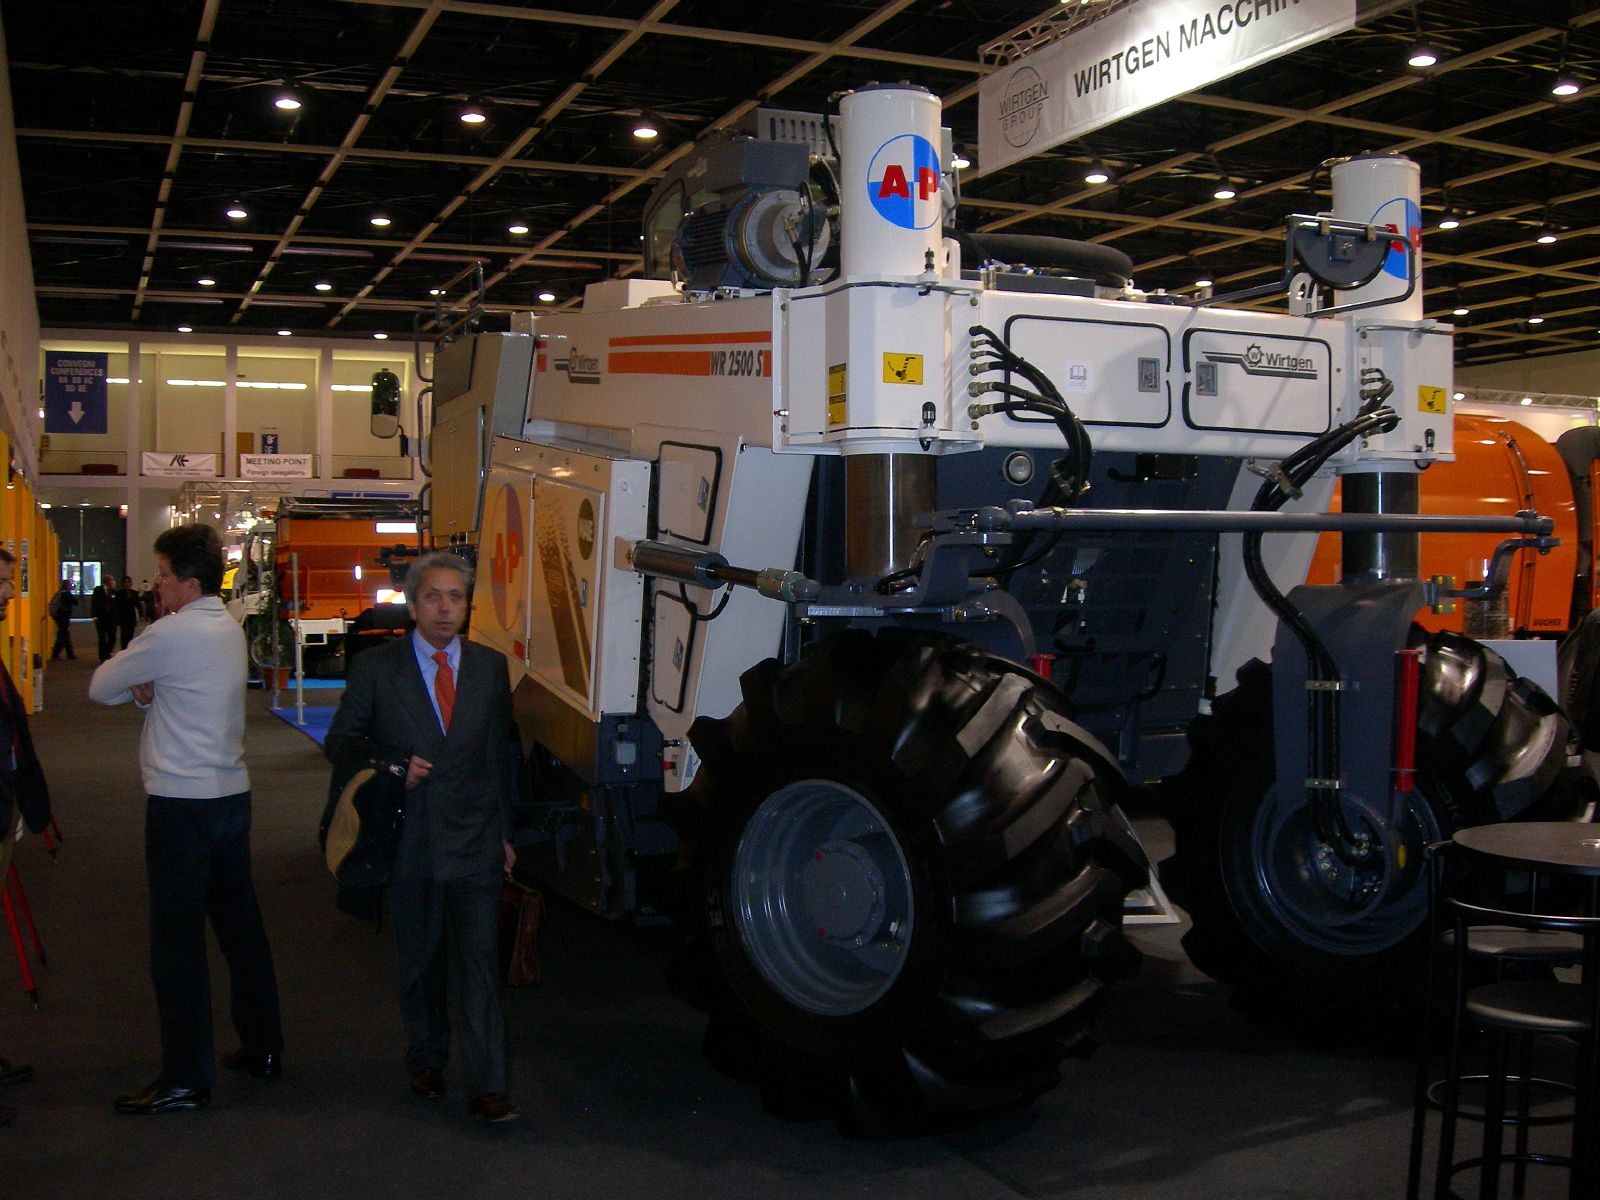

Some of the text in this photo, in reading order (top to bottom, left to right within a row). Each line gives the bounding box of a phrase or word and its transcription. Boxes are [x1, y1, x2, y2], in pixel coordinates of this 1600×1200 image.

[1074, 0, 1300, 98] WIRTGEN MACCH
[1000, 81, 1048, 116] WIRTGEN
[1002, 102, 1044, 132] GROUP
[878, 164, 938, 201] AP
[51, 368, 104, 376] CONFERENCES
[711, 350, 763, 376] WR 2500 S
[1265, 352, 1313, 371] Wirtgen
